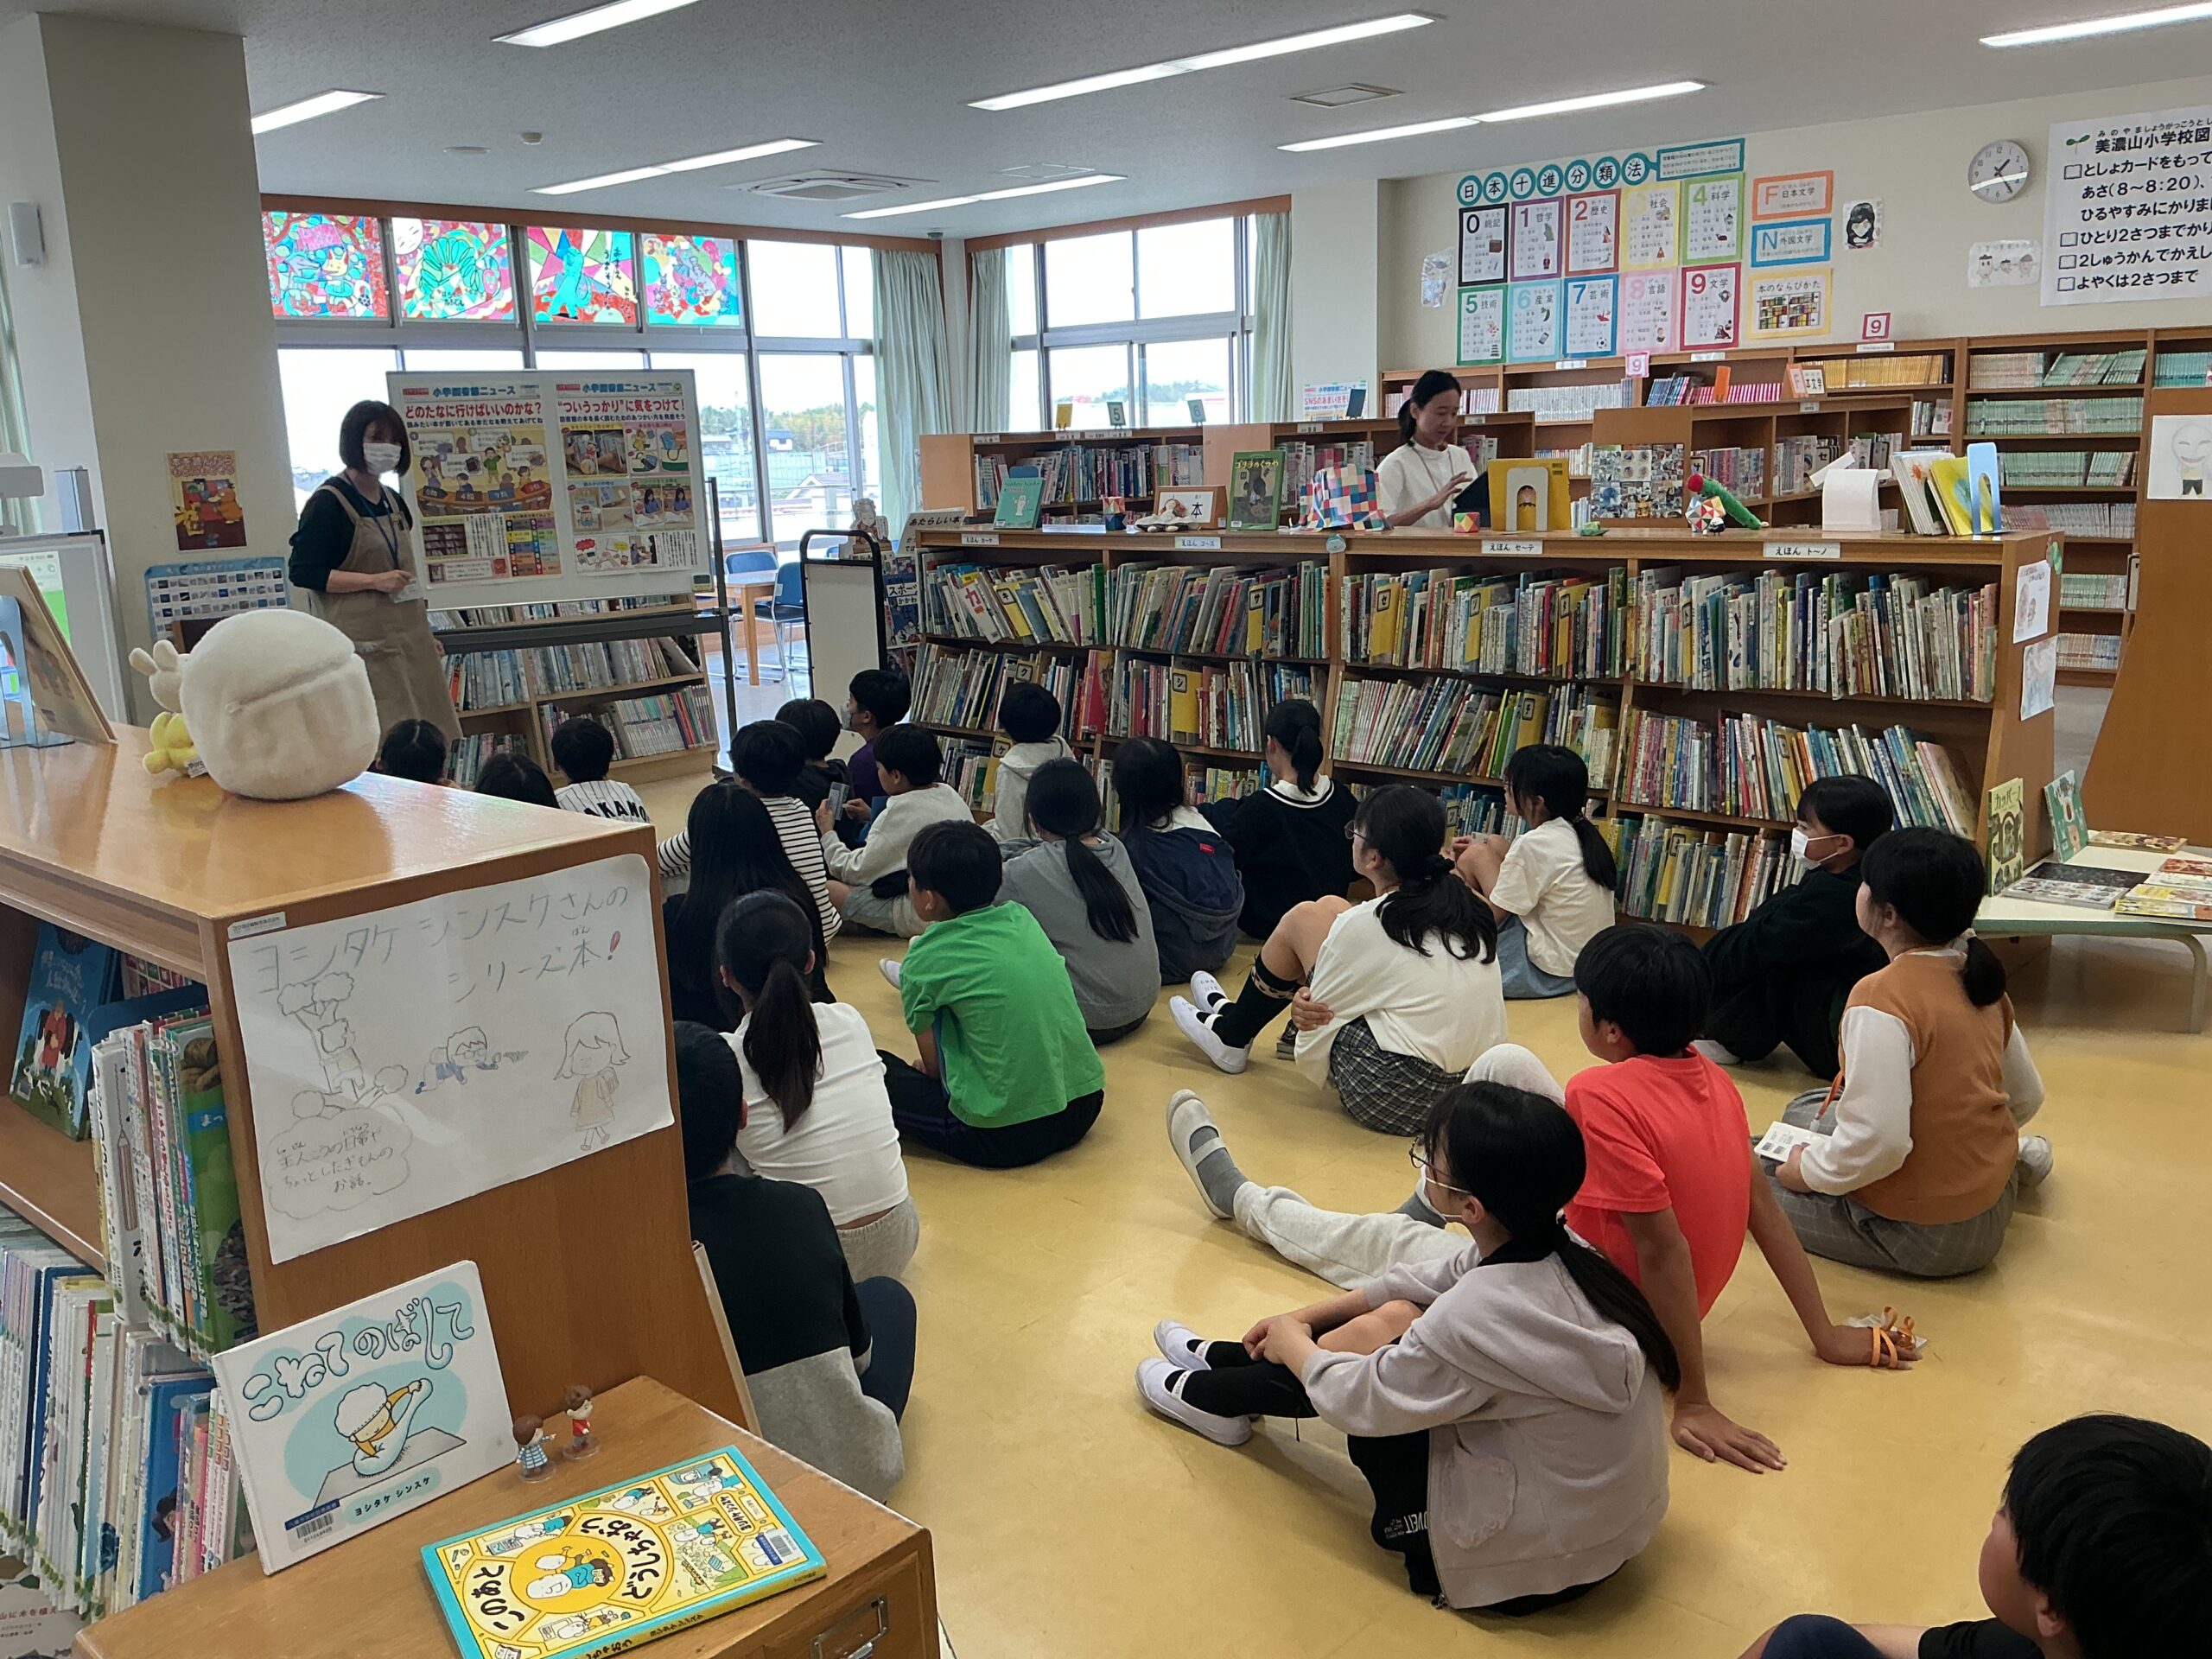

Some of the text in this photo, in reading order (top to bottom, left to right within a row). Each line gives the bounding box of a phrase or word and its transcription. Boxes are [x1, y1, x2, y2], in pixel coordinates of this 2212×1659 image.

[1465, 162, 1642, 199] 日本十進分類法
[1693, 185, 1707, 207] 4
[1765, 185, 1779, 205] F
[1783, 187, 1815, 199] 日本文学
[1574, 200, 1588, 221] 2
[1649, 199, 1668, 208] 社会
[1466, 214, 1479, 233] 0
[1521, 208, 1529, 227] 1
[1762, 231, 1777, 251] N
[1780, 235, 1813, 245] 外国文学
[1692, 273, 1706, 295] 9
[1709, 279, 1728, 289] 文学
[1758, 281, 1821, 293] 本のならびかた
[2077, 270, 2199, 290] よやくは2さつまで
[1573, 284, 1586, 304] 7
[1648, 284, 1666, 295] 言語
[1465, 295, 1478, 314] 5
[1517, 289, 1531, 309] 6
[1871, 320, 1882, 334] 9
[1632, 359, 1642, 372] 9
[1113, 408, 1120, 421] 5
[1193, 405, 1200, 417] 6
[1818, 452, 1827, 461] セ
[1191, 502, 1204, 518] 本
[909, 516, 962, 526] あたらしい本
[1776, 546, 1801, 556] えほん
[1254, 593, 1261, 604] サ
[1381, 595, 1389, 606] セ
[243, 1297, 475, 1421] こねてのばして
[354, 1494, 391, 1517] ヨシタケ
[395, 1476, 431, 1500] シンスケ
